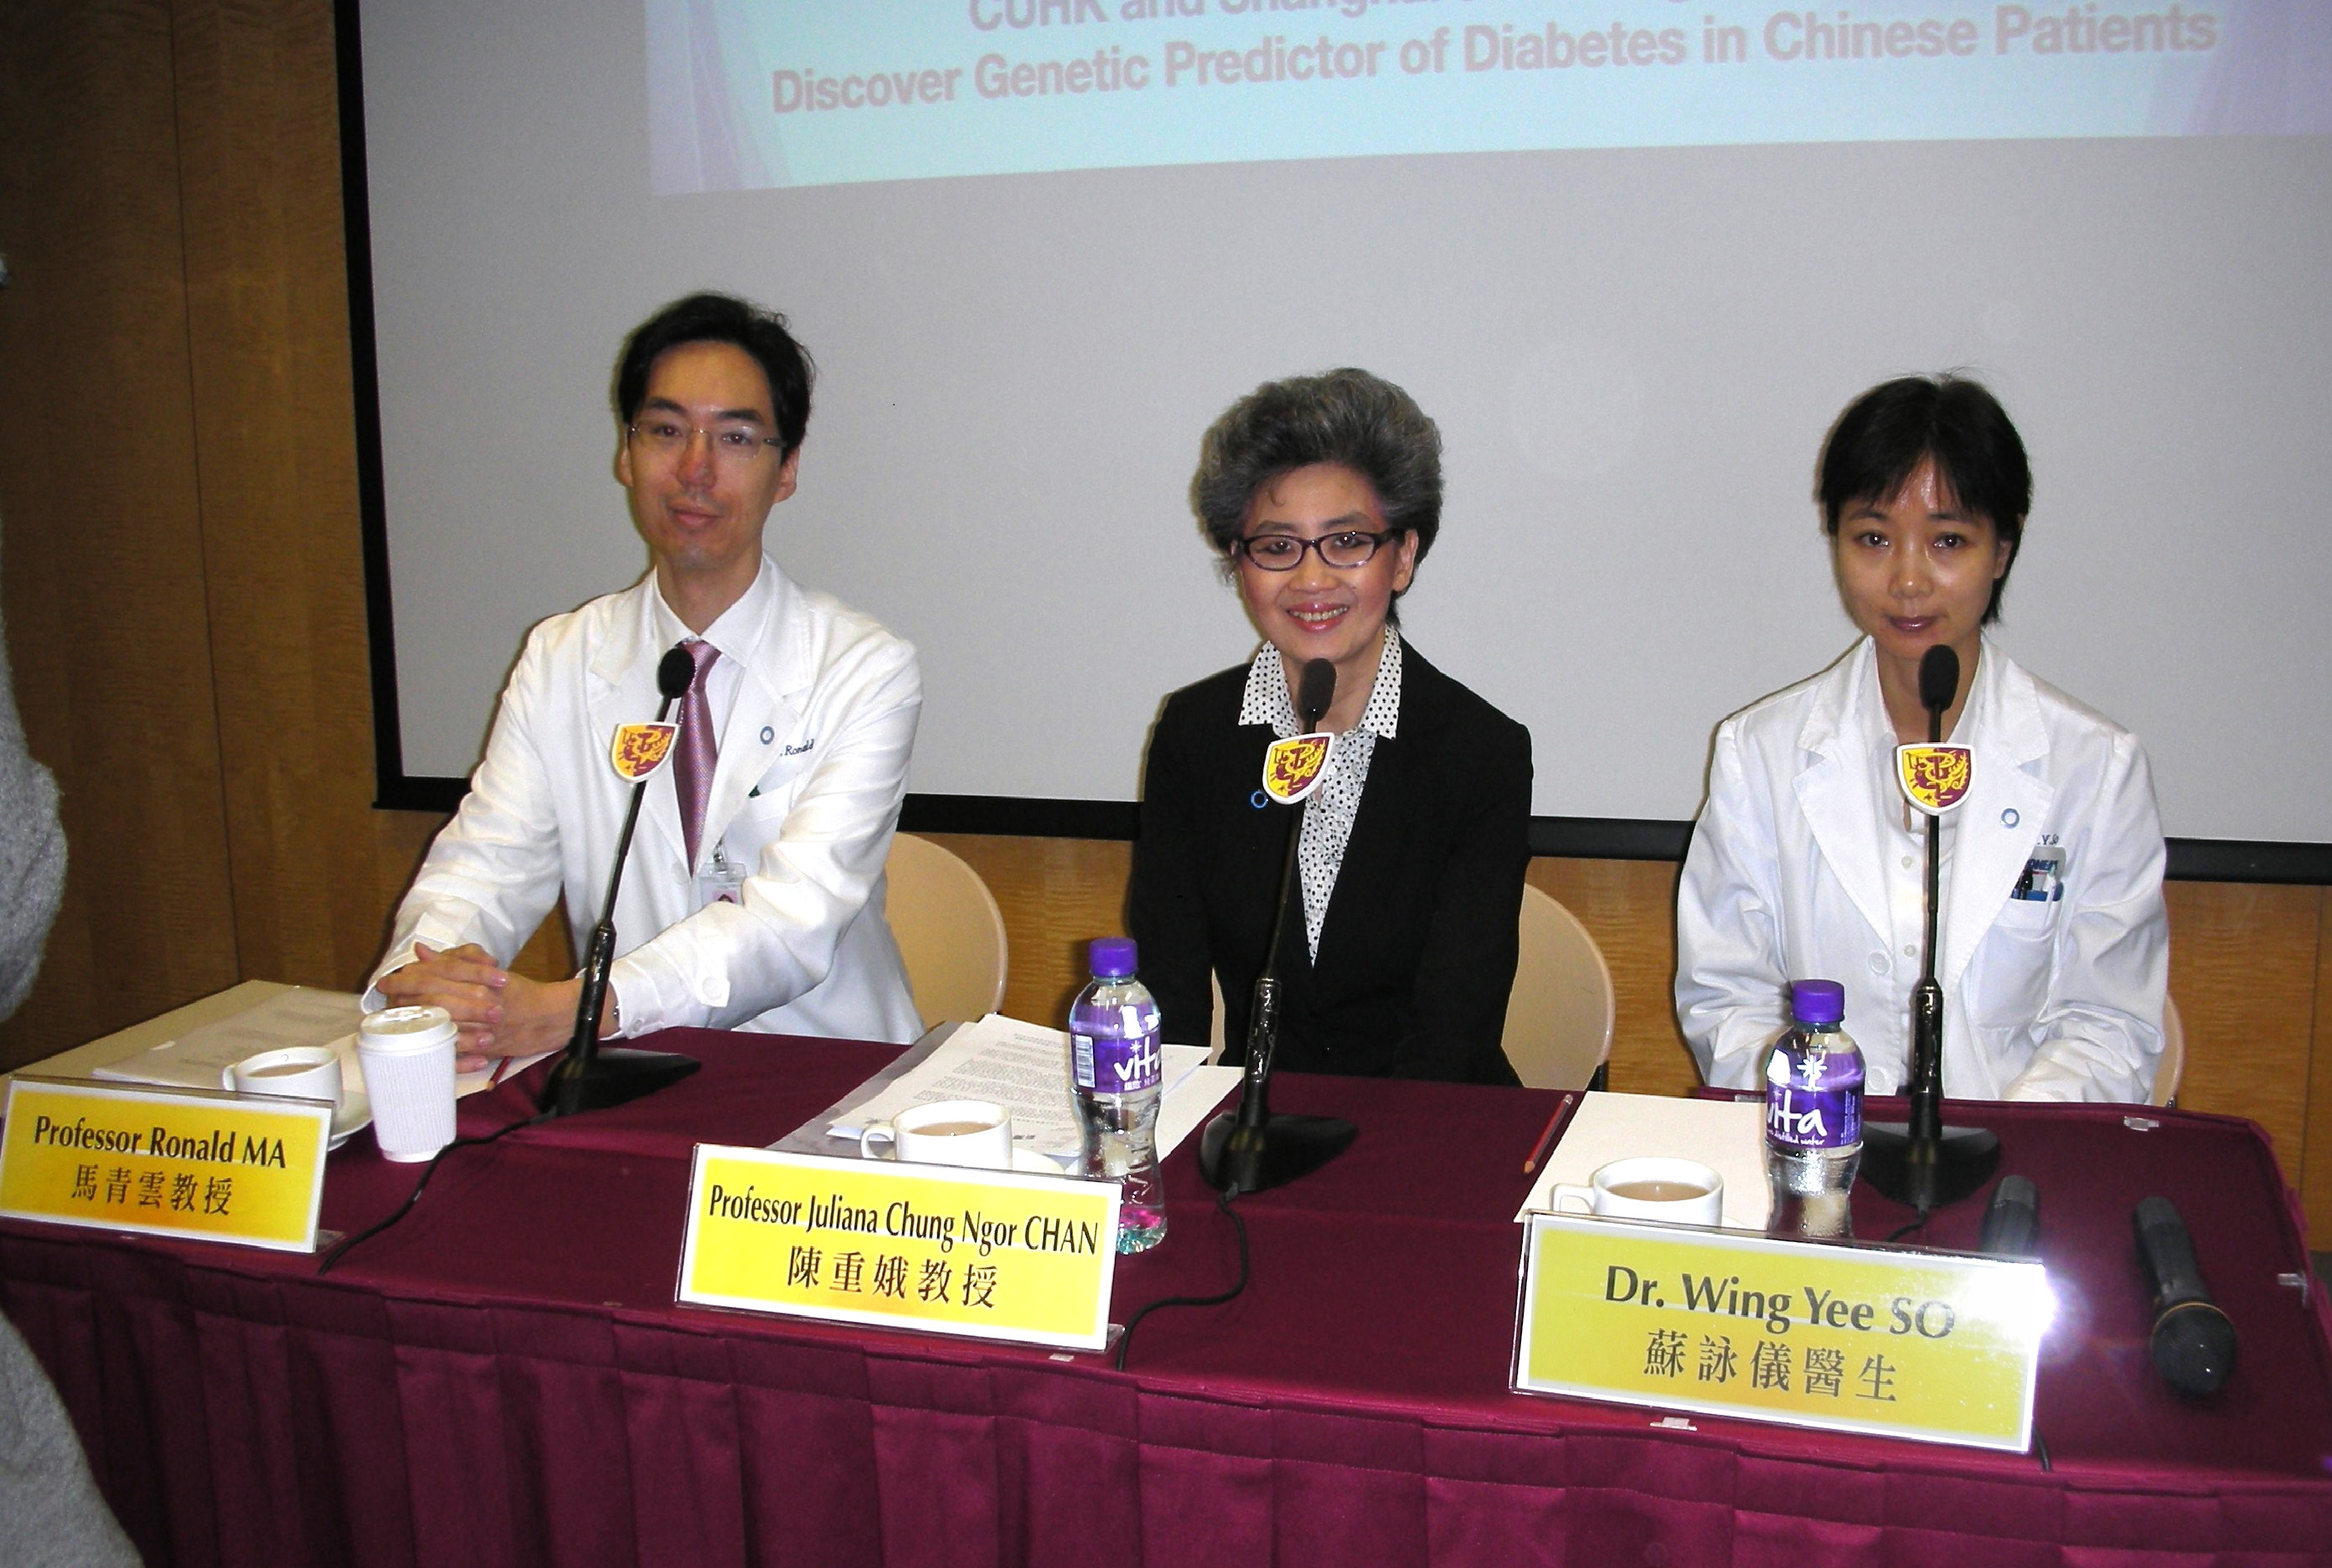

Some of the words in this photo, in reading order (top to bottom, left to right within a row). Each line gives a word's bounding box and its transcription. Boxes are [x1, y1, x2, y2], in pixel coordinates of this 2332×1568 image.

[772, 68, 962, 114] Discover
[974, 44, 1150, 99] Genetic
[1164, 35, 1386, 87] Predictor
[1399, 26, 1451, 75] of
[1463, 20, 1688, 72] Diabetes
[1703, 14, 1747, 64] in
[1762, 10, 1978, 61] Chinese
[1995, 3, 2218, 55] Patients
[34, 1115, 142, 1154] Professor
[149, 1127, 236, 1163] Ronald
[242, 1135, 286, 1168] MA
[70, 1163, 234, 1215] 馬青雲教授
[709, 1184, 802, 1225] Professor
[806, 1194, 878, 1233] Juliana
[886, 1201, 956, 1253] Chung
[962, 1210, 1018, 1257] Ngor
[1024, 1215, 1098, 1256] CHAN
[787, 1245, 998, 1309] 陳重娥教授
[1605, 1265, 1664, 1308] Dr.
[1682, 1272, 1793, 1334] Wing
[1803, 1286, 1875, 1331] Yee
[1890, 1297, 1955, 1338] SO
[1643, 1328, 1896, 1402] 蘇詠儀醫生
